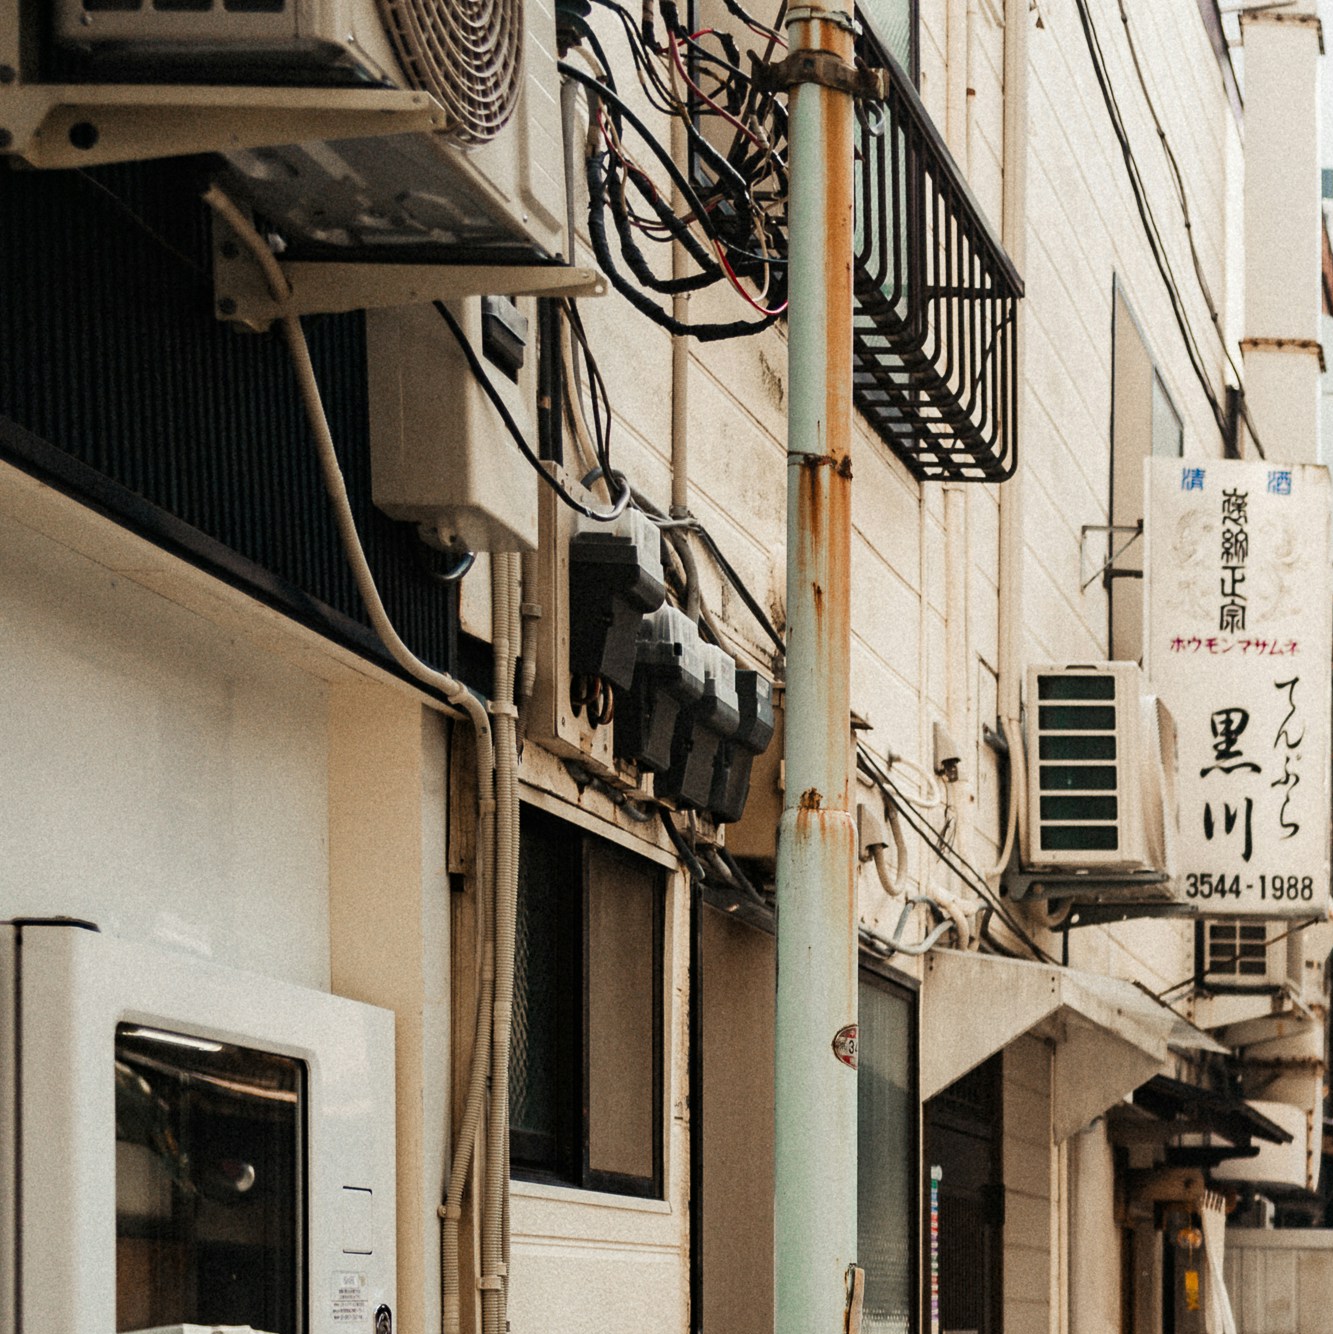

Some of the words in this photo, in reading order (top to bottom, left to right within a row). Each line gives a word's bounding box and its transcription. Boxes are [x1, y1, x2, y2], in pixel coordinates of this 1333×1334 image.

[1170, 635, 1300, 656] ホウモンマサムネ
[1200, 707, 1262, 863] 黒川
[1185, 872, 1314, 901] 3544-1988
